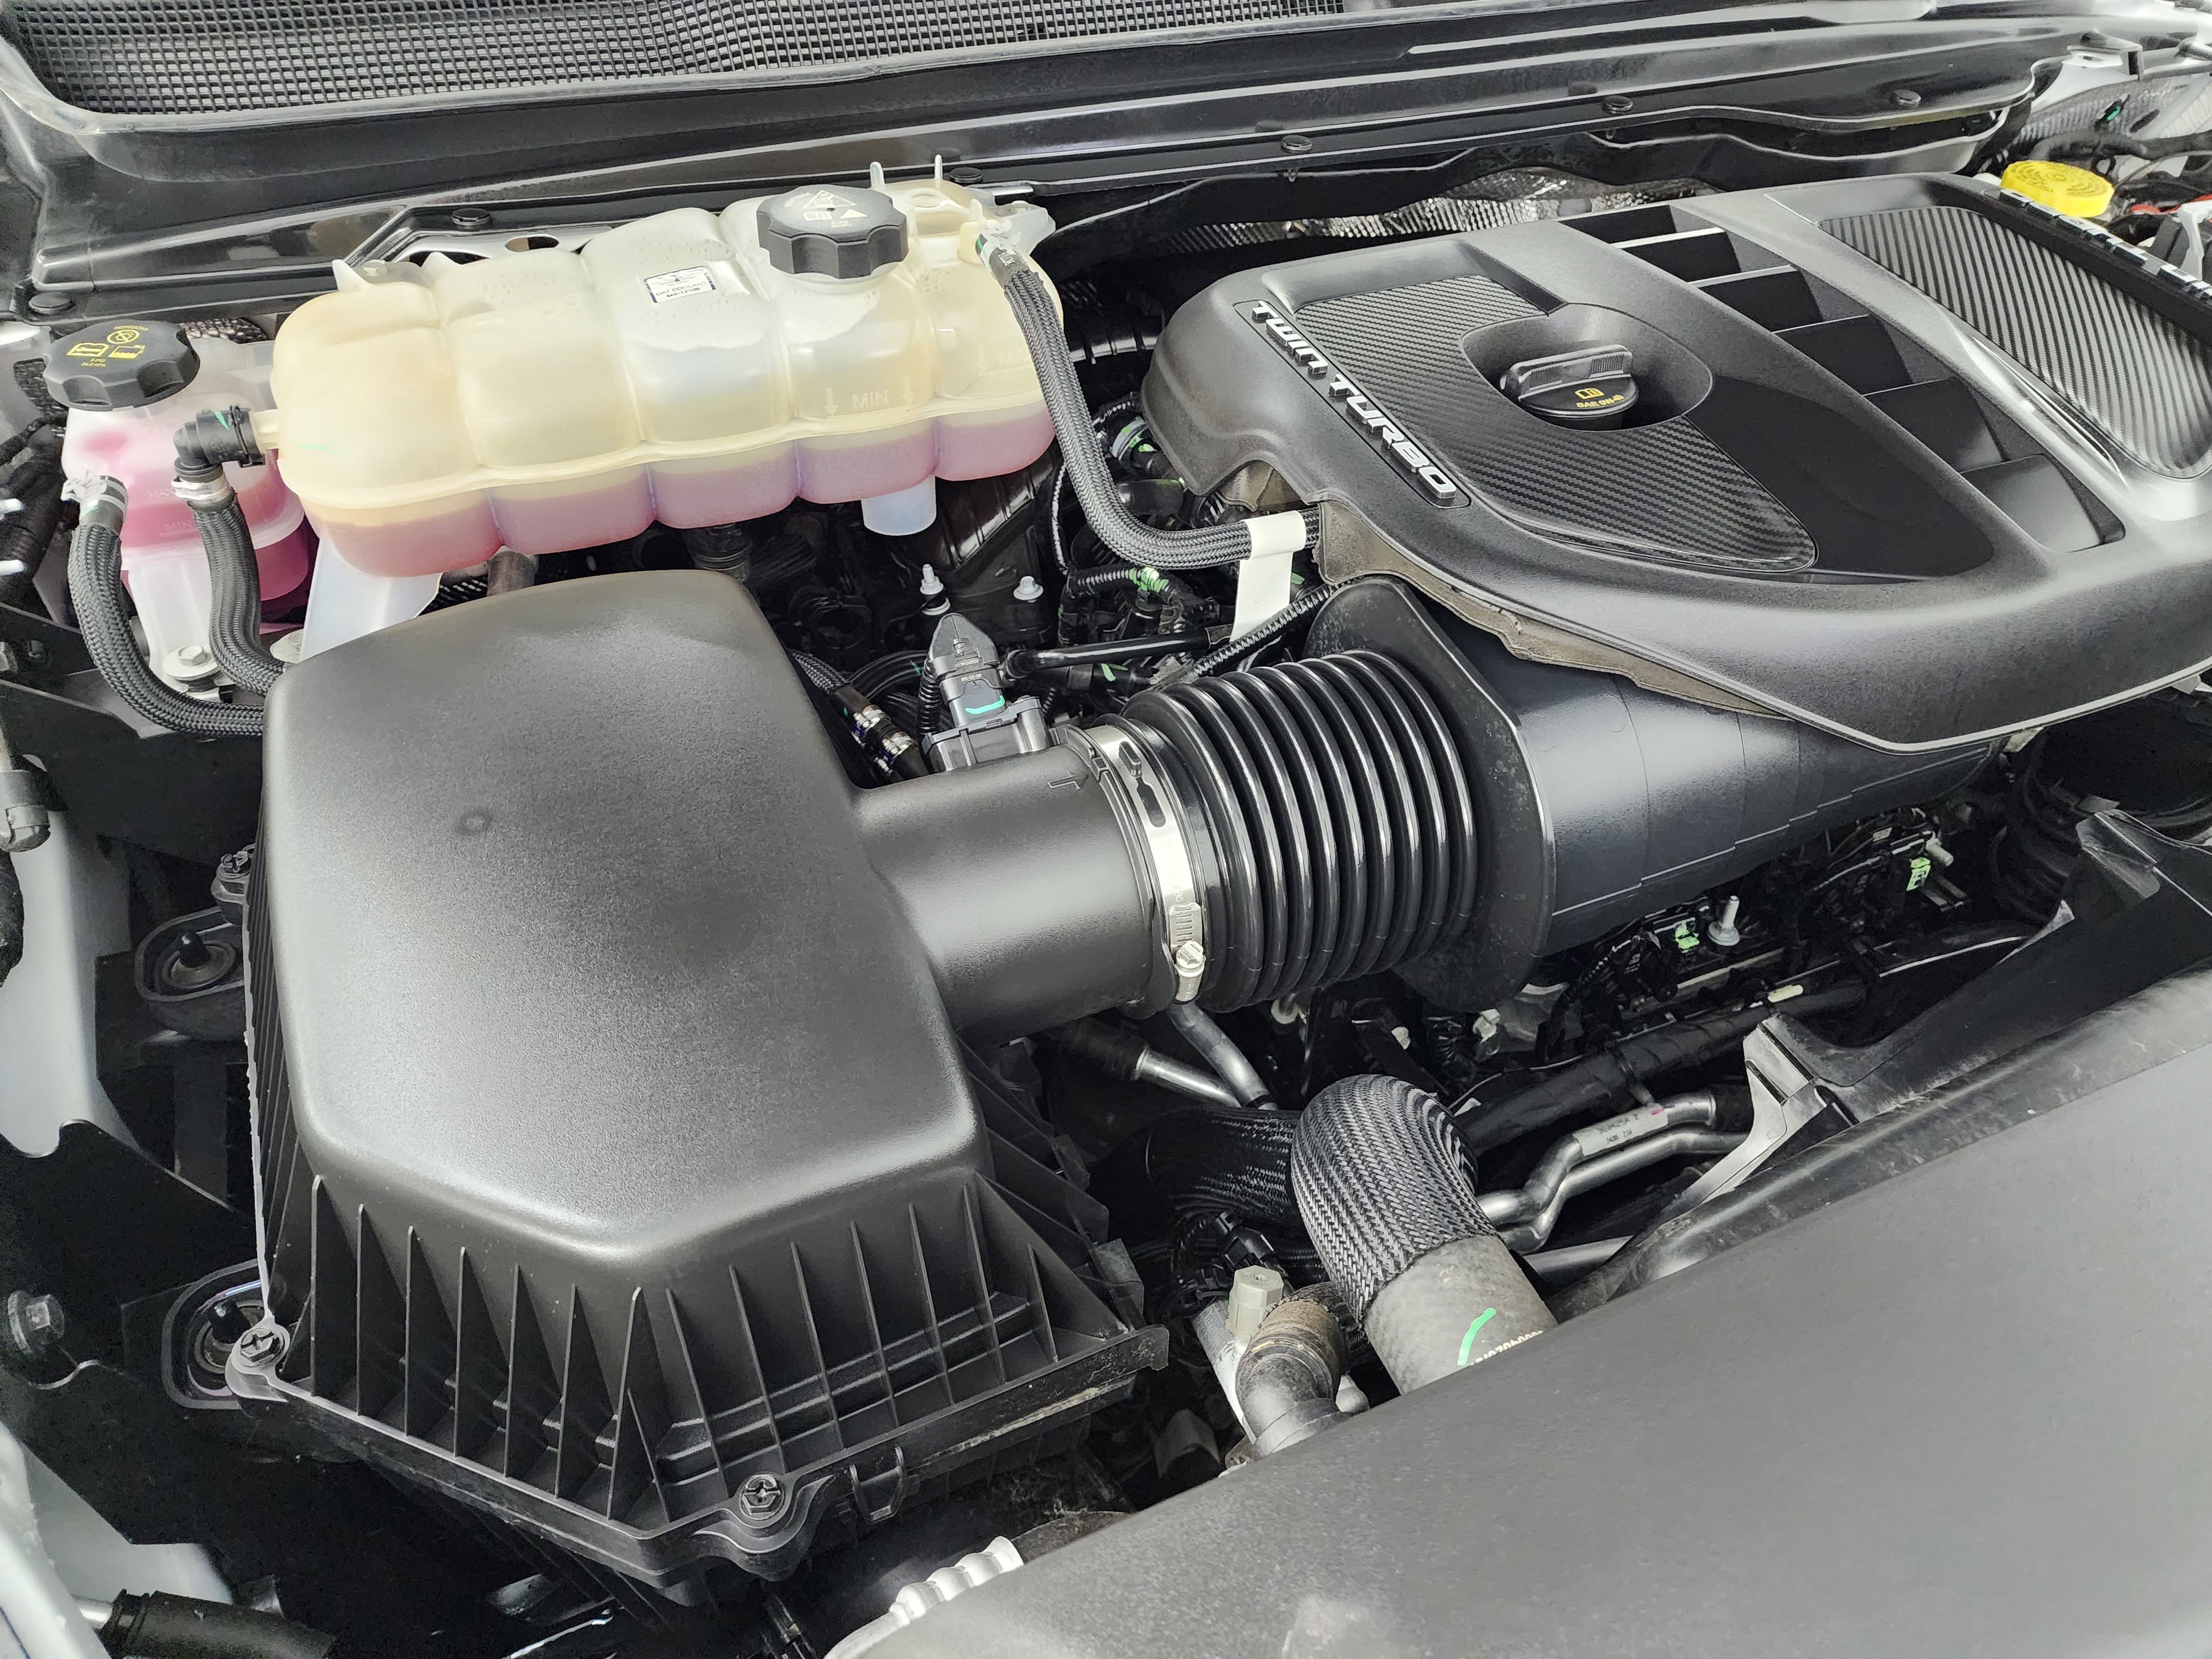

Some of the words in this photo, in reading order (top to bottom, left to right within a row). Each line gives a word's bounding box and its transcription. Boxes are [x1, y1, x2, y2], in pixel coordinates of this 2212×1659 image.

[671, 281, 707, 292] COOLANT
[998, 347, 1028, 366] MA
[852, 389, 890, 410] MIN
[1251, 300, 1329, 375] TWIN
[1329, 373, 1458, 499] TURBO
